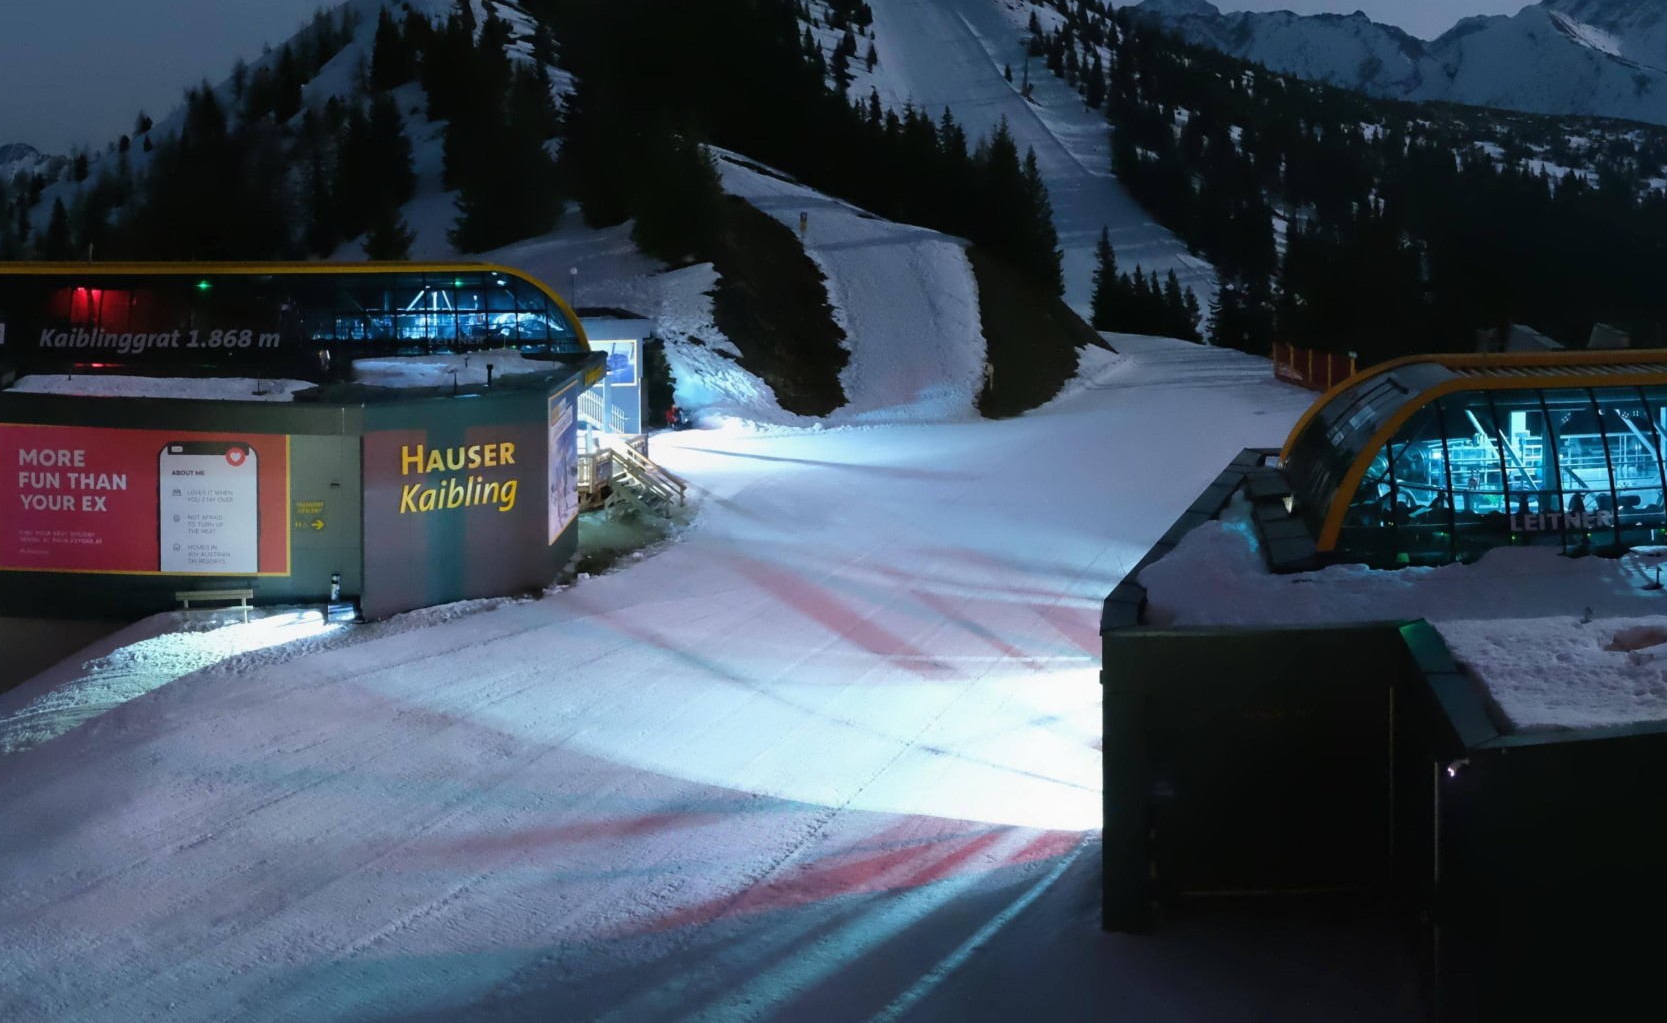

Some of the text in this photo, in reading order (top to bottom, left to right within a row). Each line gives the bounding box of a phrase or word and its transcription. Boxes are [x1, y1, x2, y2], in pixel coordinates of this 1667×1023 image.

[39, 327, 281, 354] Kaiblinggrat 1.868 m
[18, 448, 85, 467] MORE
[401, 442, 516, 475] HAUSER
[18, 472, 127, 490] FUN THAN
[20, 494, 107, 512] YOUR EX
[400, 476, 518, 514] Kaibling
[1510, 510, 1612, 531] LEITNER
